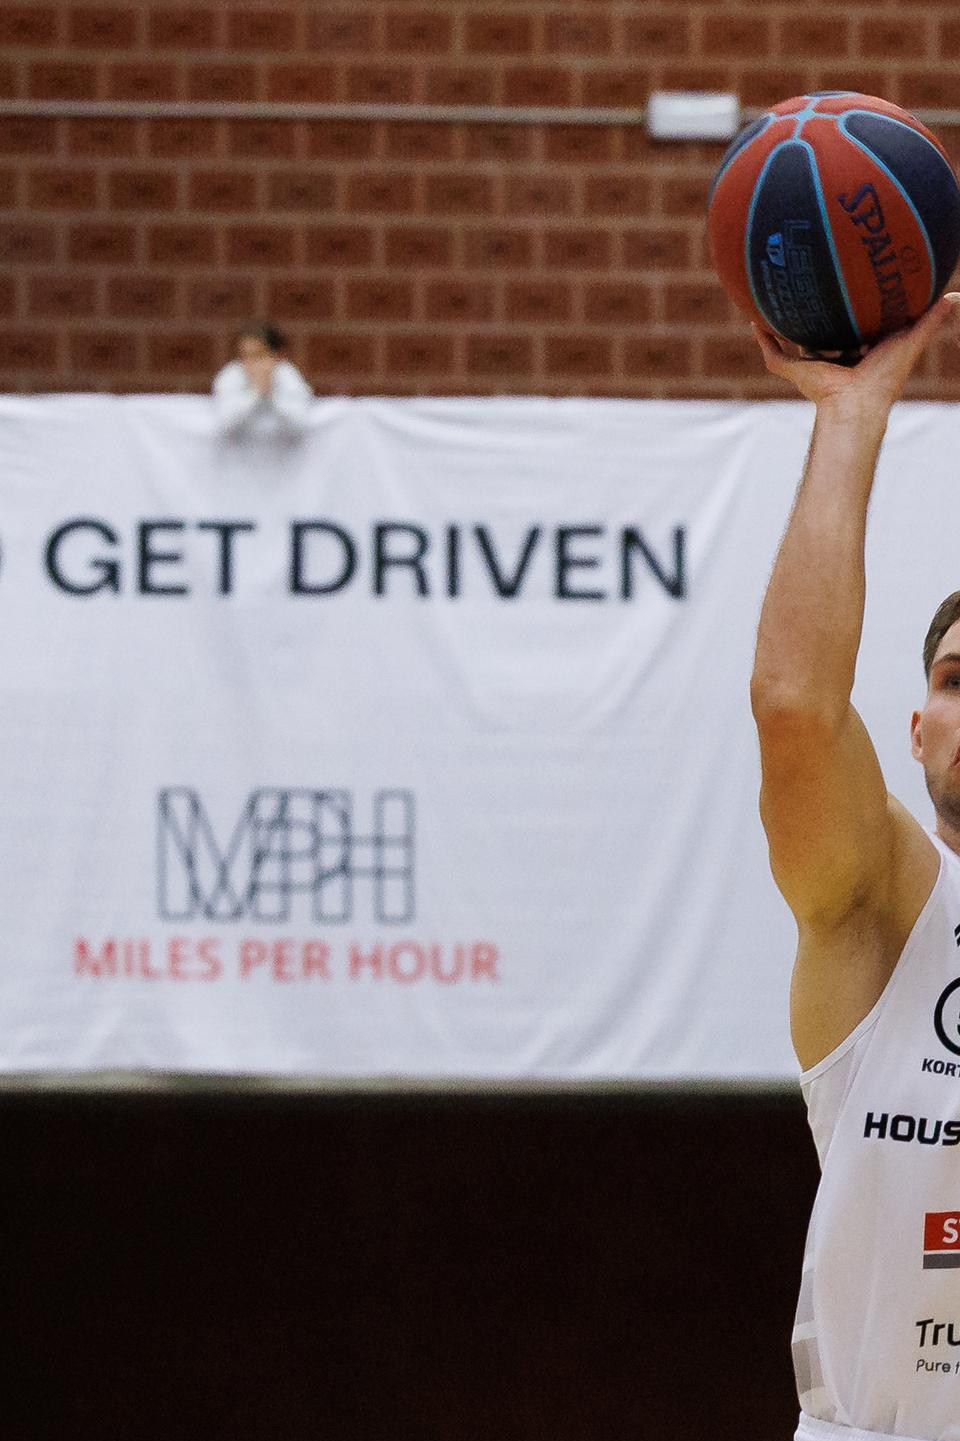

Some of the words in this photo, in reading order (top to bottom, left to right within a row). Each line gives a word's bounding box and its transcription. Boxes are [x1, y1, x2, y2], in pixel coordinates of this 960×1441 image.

[44, 517, 256, 597] GET
[288, 520, 688, 602] DRIVEN
[72, 936, 222, 982] MILES
[238, 937, 332, 984] PER
[347, 939, 500, 986] HOUR
[915, 1359, 951, 1373] Pure
